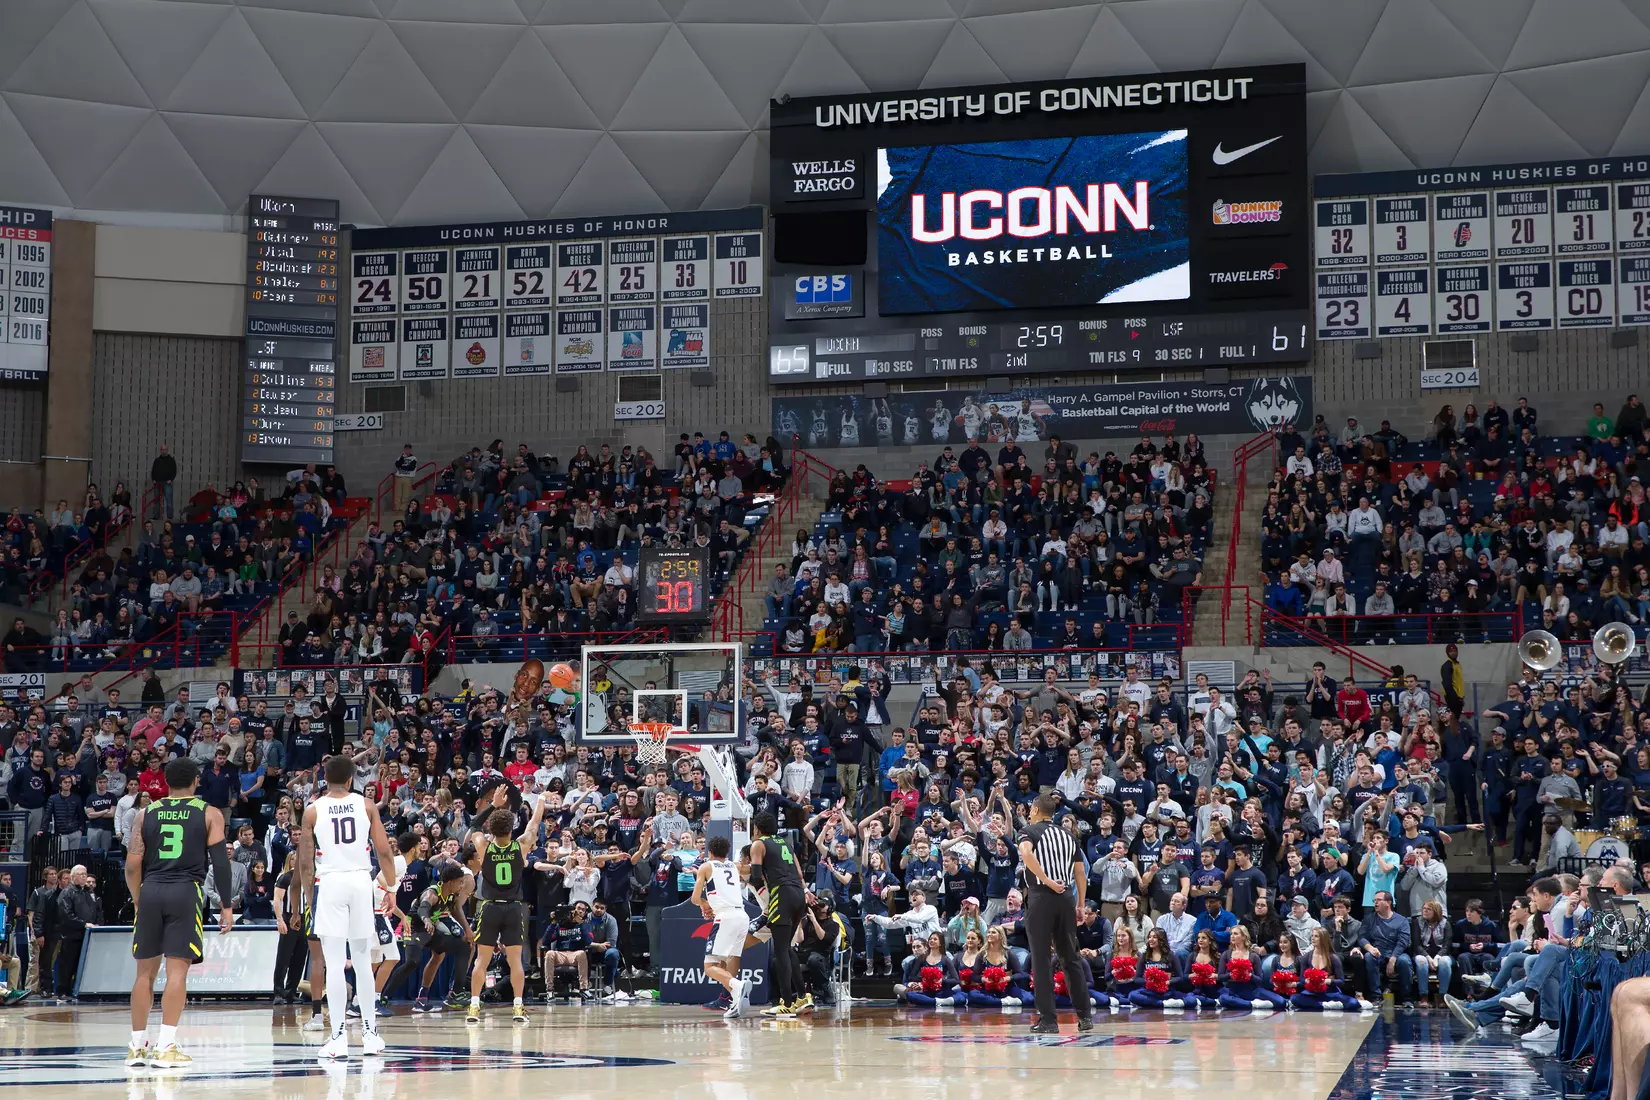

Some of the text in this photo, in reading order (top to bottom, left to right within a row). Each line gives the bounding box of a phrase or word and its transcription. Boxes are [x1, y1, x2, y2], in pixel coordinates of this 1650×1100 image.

[816, 78, 1253, 128] UNIVERSITY OF CONNECTICUT
[792, 159, 856, 176] WELLS
[1418, 164, 1610, 185] UCONN HUSKIES OF
[794, 177, 854, 192] FARGO
[1511, 193, 1533, 202] RENEE
[1574, 189, 1591, 198] TINA
[1231, 201, 1282, 212] DUNKIN'
[1390, 201, 1412, 210] DIANA
[1453, 197, 1470, 206] GENO
[1567, 200, 1599, 211] CHARLES
[911, 182, 1149, 243] UCONN
[1333, 204, 1350, 213] SWIN
[1442, 207, 1483, 219] AURIEMMA
[1498, 203, 1546, 215] MONTGOMERY
[1231, 211, 1280, 223] DONUTS
[1332, 214, 1352, 224] CASH
[1385, 210, 1418, 221] TAURASI
[440, 218, 668, 240] UCONN HUSKIES OF HONOR
[1512, 218, 1534, 244] 20
[1573, 214, 1594, 241] 31
[732, 237, 744, 246] SUE
[1332, 228, 1352, 254] 32
[1396, 226, 1407, 250] 3
[17, 245, 44, 262] 1995
[618, 243, 647, 252] SVETLANA
[730, 247, 746, 257] BIRD
[463, 250, 492, 260] JENNIFER
[612, 252, 653, 263] ABROSIMOVA
[674, 250, 696, 260] RALPH
[948, 245, 1112, 267] BASKETBALL
[1380, 254, 1424, 262] 2000-2004
[418, 263, 434, 273] LOBO
[462, 260, 493, 270] RIZZOTTI
[514, 258, 543, 268] WOLTERS
[1574, 263, 1596, 272] CHRIS
[676, 263, 695, 288] 33
[729, 260, 747, 285] 10
[1509, 265, 1538, 275] MORGAN
[15, 270, 44, 288] 2002
[564, 268, 597, 292] 42
[620, 266, 645, 290] 25
[1209, 270, 1274, 283] TRAVELERS
[1328, 275, 1358, 284] KALEENA
[1389, 272, 1416, 282] MORIAH
[1515, 276, 1534, 287] TUCK
[1572, 274, 1599, 285] DAILEY
[409, 276, 442, 300] 50
[463, 274, 491, 298] 21
[513, 271, 544, 296] 52
[796, 275, 847, 292] CBS
[1318, 284, 1368, 295] MOSQUEDA-LEWIS
[1382, 283, 1423, 294] JEFFERSON
[1445, 279, 1480, 291] STEWART
[358, 279, 391, 303] 24
[14, 297, 44, 314] 2009
[1446, 293, 1479, 322] 30
[1516, 290, 1532, 317] 3
[1568, 288, 1602, 316] CD
[619, 309, 645, 319] NATIONAL
[672, 307, 698, 317] NATIONAL
[803, 305, 821, 313] Xerox
[822, 305, 852, 314] Company
[1326, 300, 1359, 327] 23
[1394, 298, 1410, 323] 4
[463, 317, 490, 327] NATIONAL
[512, 315, 542, 324] NATIONAL
[565, 312, 594, 322] NATIONAL
[671, 317, 699, 328] CHAMPION
[1124, 318, 1147, 328] POSS
[360, 322, 388, 331] NATIONAL
[411, 320, 438, 329] NATIONAL
[511, 325, 544, 335] CHAMPION
[563, 322, 596, 333] CHAMPION
[618, 319, 646, 330] CHAMPION
[1079, 320, 1107, 330] BONUS
[14, 323, 41, 340] 2016
[409, 330, 441, 340] CHAMPION
[460, 327, 493, 338] CHAMPION
[921, 328, 942, 337] POSS
[959, 326, 987, 336] BONUS
[1017, 325, 1063, 348] 2:59
[358, 332, 390, 343] CHAMPION
[1272, 324, 1306, 351] 61
[1089, 350, 1140, 364] TM FLS 9
[1155, 348, 1192, 361] 30 SEC
[1220, 346, 1245, 358] FULL
[777, 347, 807, 374] 65
[932, 358, 978, 370] 7 TM FLS
[1006, 353, 1027, 367] 2nd
[828, 363, 852, 375] FULL
[878, 361, 913, 374] 30 SEC
[1422, 371, 1478, 384] SEC 204
[1048, 387, 1244, 406] Harry A. Gampel Pavilion Storrs, CT
[616, 404, 664, 416] SEC 202
[1062, 402, 1230, 418] Basketball Capital of the World
[357, 416, 382, 427] 201
[661, 560, 698, 578] 2:59
[656, 581, 692, 613] 30
[20, 674, 44, 685] 201
[92, 799, 111, 807] UCONN
[328, 804, 354, 814] ADAMS
[158, 810, 190, 820] RIDEAU
[331, 817, 356, 845] 10
[158, 824, 184, 859] 3
[491, 853, 515, 861] COLLINS
[782, 845, 794, 864] 4
[1138, 854, 1158, 862] UCONN
[495, 862, 512, 885] 0
[724, 870, 734, 886] 2
[403, 882, 412, 892] 15
